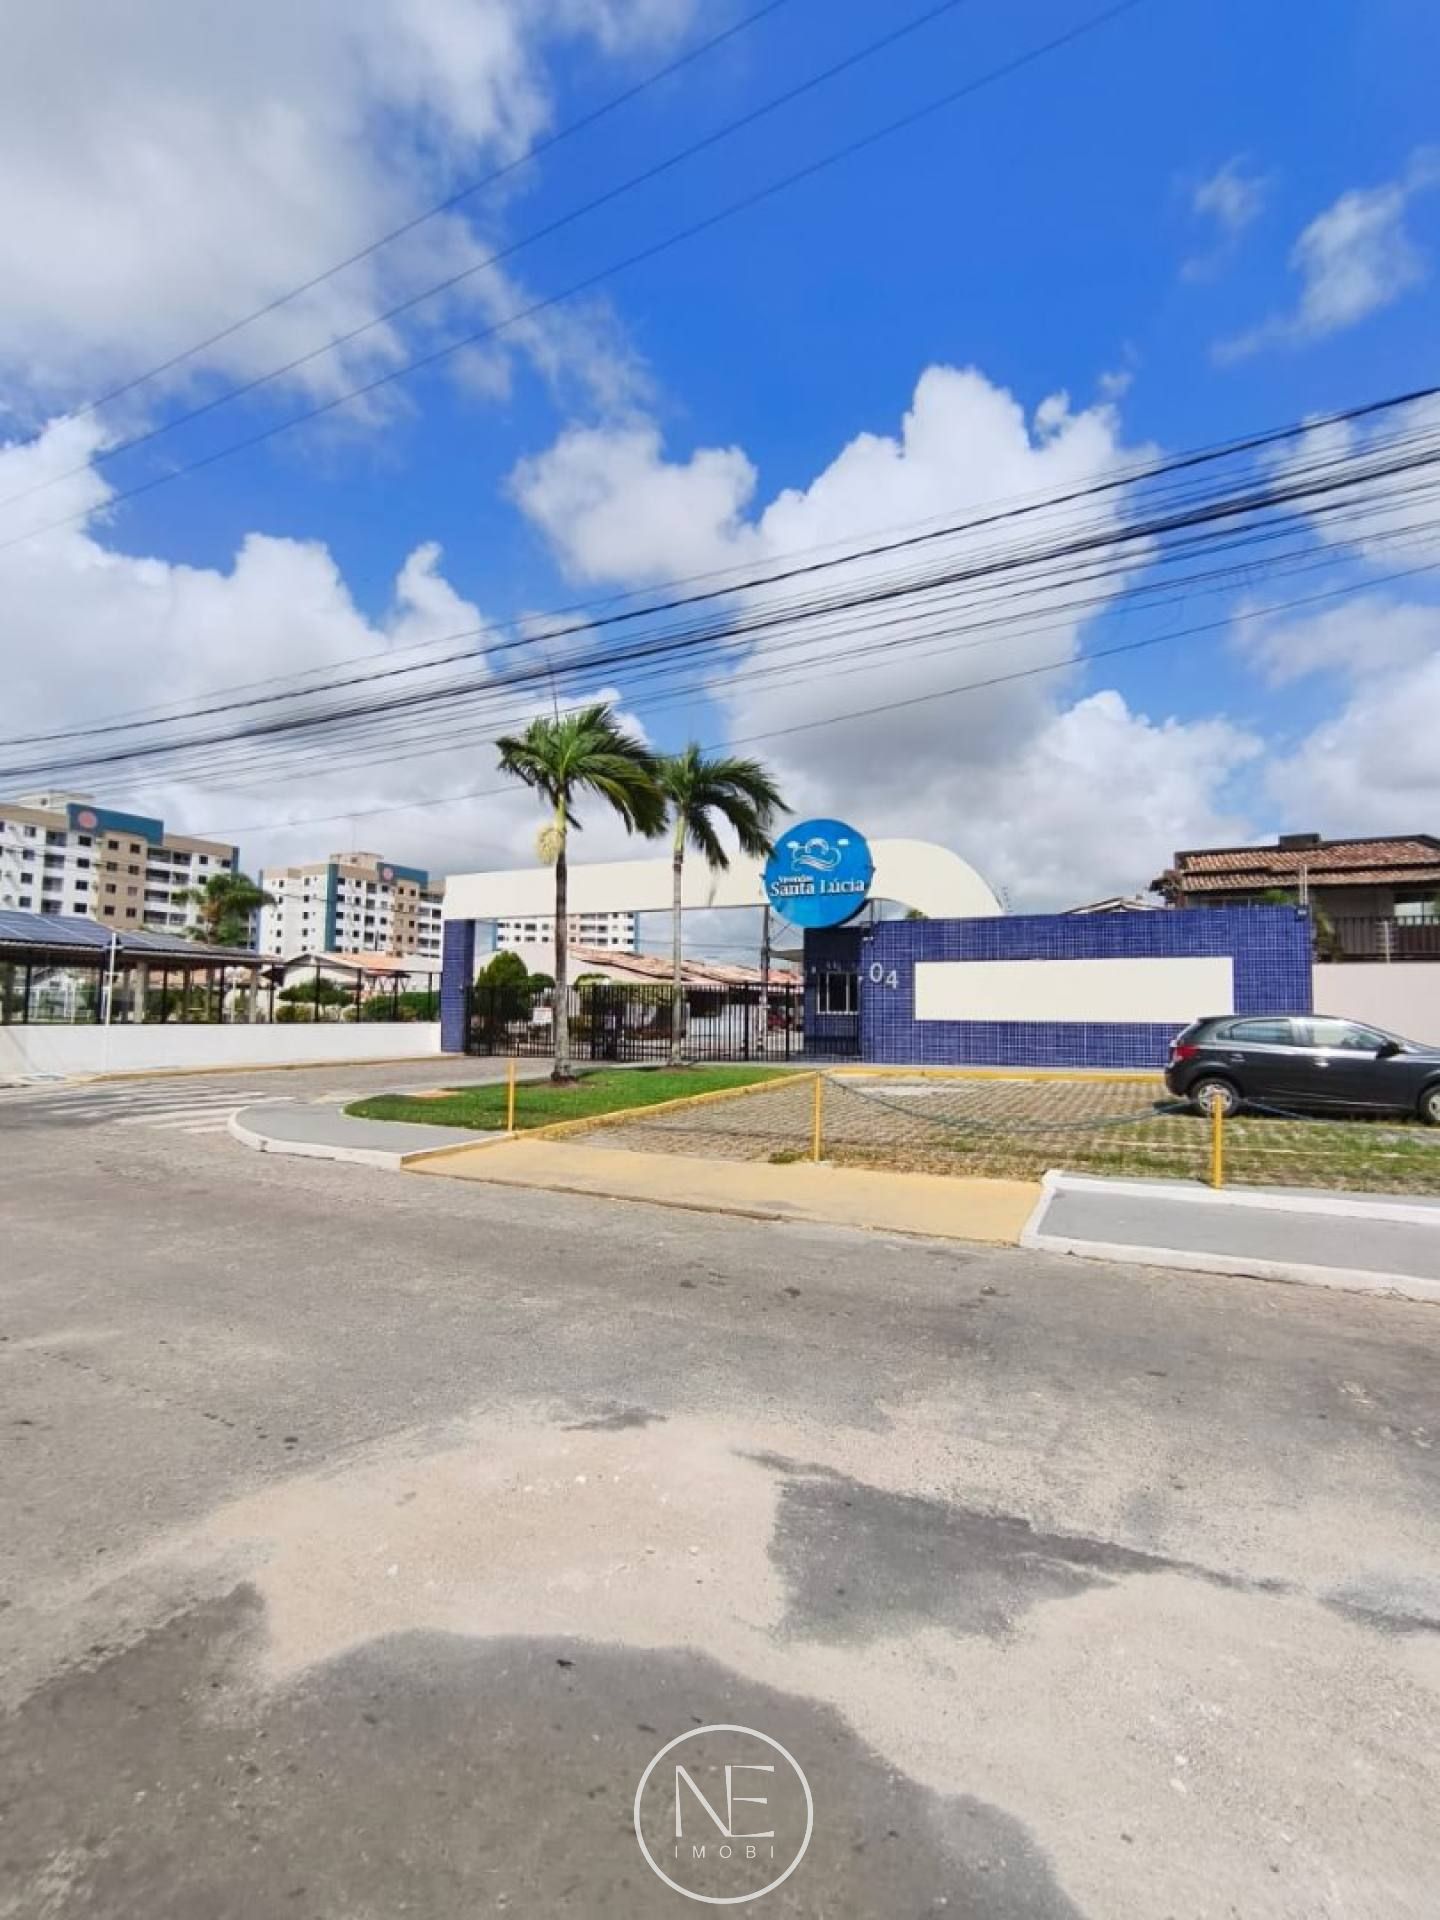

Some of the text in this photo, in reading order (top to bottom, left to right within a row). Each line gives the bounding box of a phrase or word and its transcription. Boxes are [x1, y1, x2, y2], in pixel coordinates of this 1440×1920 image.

[770, 881, 815, 897] Santa
[820, 878, 865, 894] Lúcia
[870, 962, 899, 990] 04
